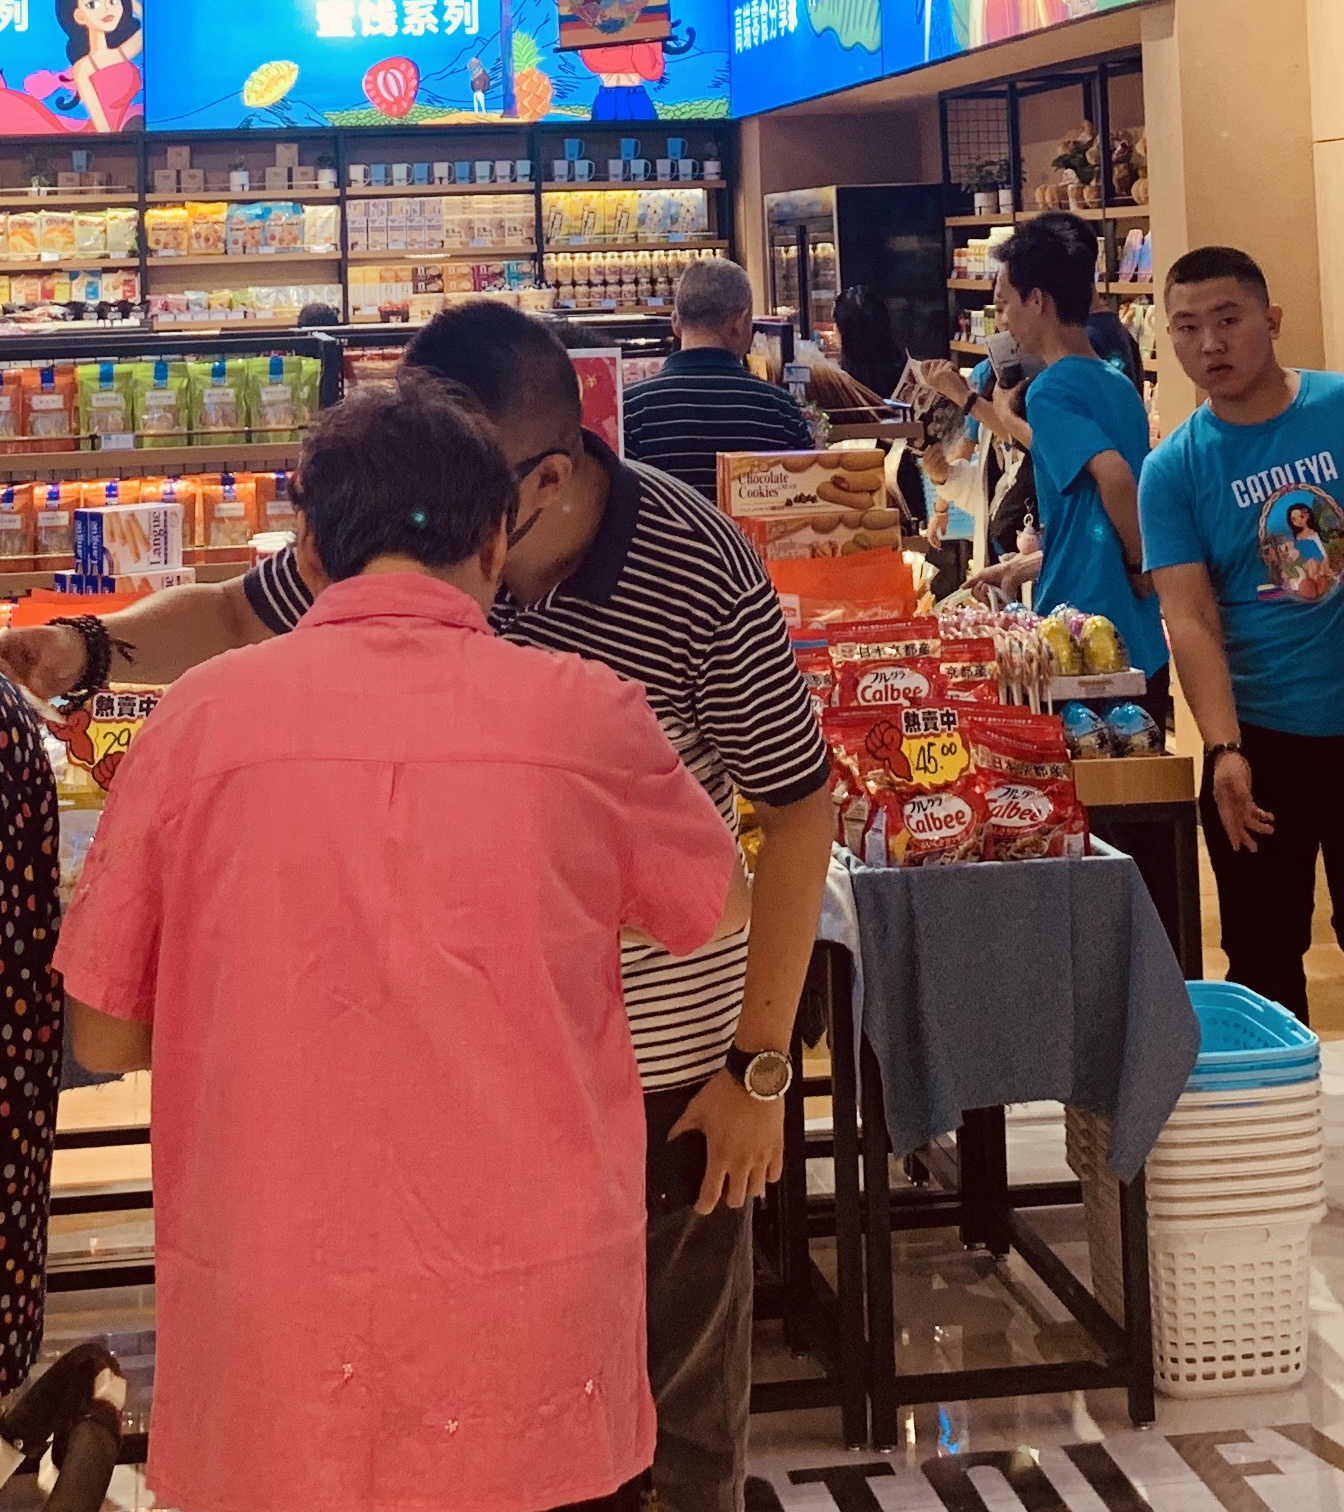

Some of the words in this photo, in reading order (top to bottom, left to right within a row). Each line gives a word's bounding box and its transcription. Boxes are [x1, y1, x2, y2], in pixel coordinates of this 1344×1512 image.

[738, 471, 789, 486] Chocolate
[738, 484, 779, 499] Cookies
[150, 510, 164, 566] Langue
[860, 681, 923, 704] Calbee
[95, 695, 158, 718] 熱賣中
[904, 710, 957, 733] 熱賣中
[906, 808, 967, 835] Calbee
